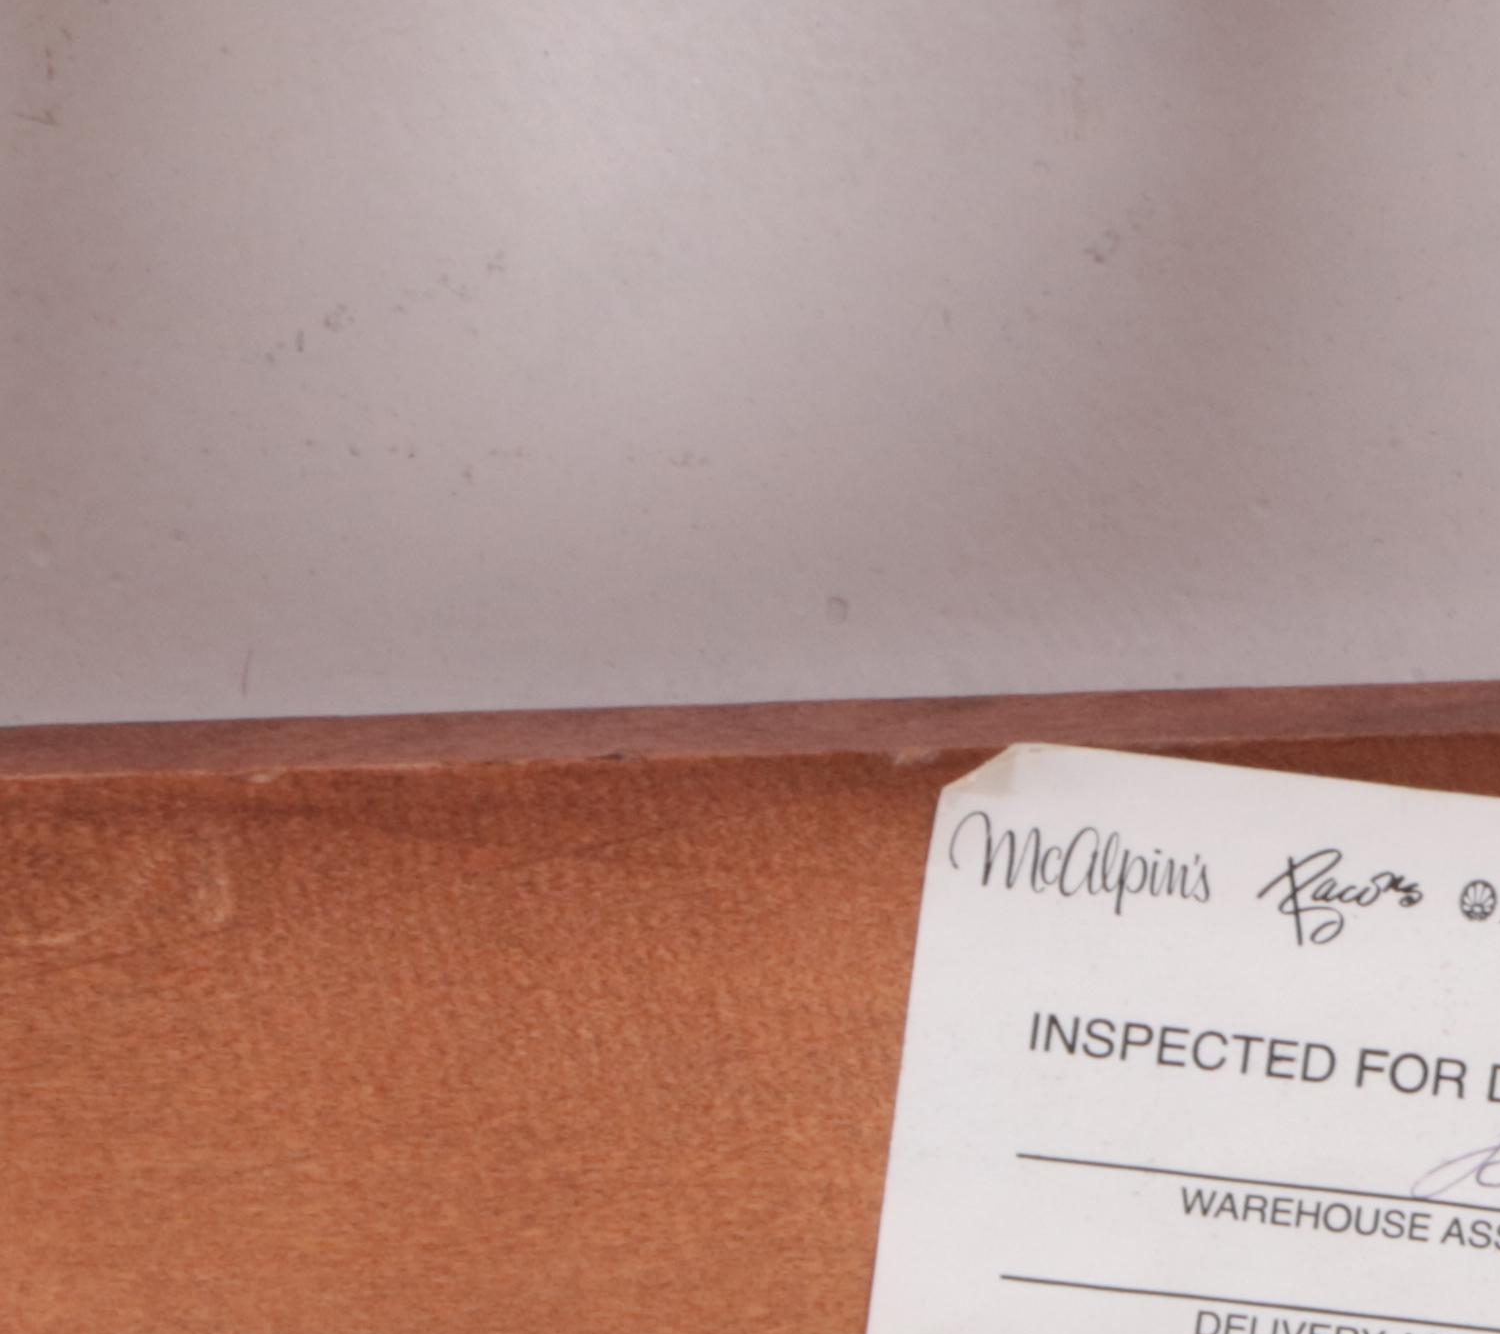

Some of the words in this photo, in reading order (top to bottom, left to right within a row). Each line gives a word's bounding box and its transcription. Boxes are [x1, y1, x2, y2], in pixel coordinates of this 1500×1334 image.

[950, 810, 1212, 917] McAlpin's
[1029, 1012, 1336, 1083] INSPECTED
[1356, 1048, 1467, 1099] FOR
[1182, 1187, 1431, 1242] WAREHOUSE
